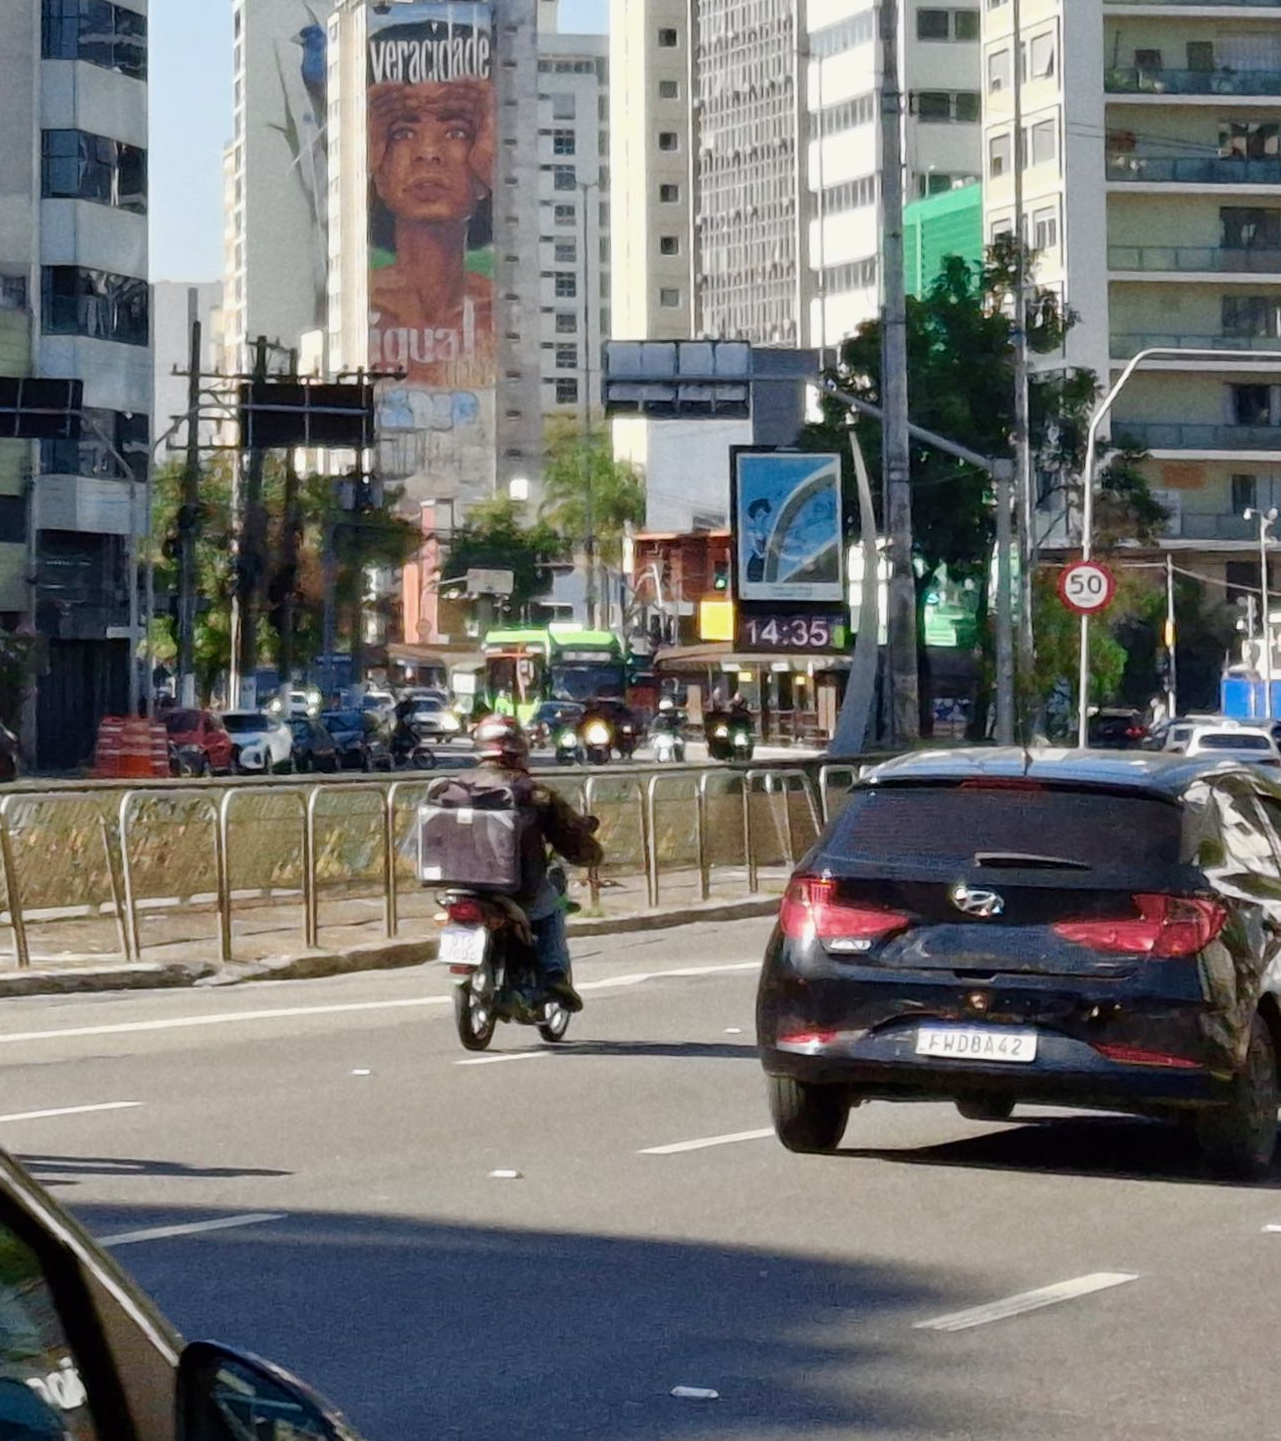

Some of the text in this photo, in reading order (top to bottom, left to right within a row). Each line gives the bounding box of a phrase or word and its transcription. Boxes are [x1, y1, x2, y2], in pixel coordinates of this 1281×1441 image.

[369, 8, 490, 84] veracidade
[1070, 574, 1102, 594] 50
[746, 619, 828, 646] 14:35
